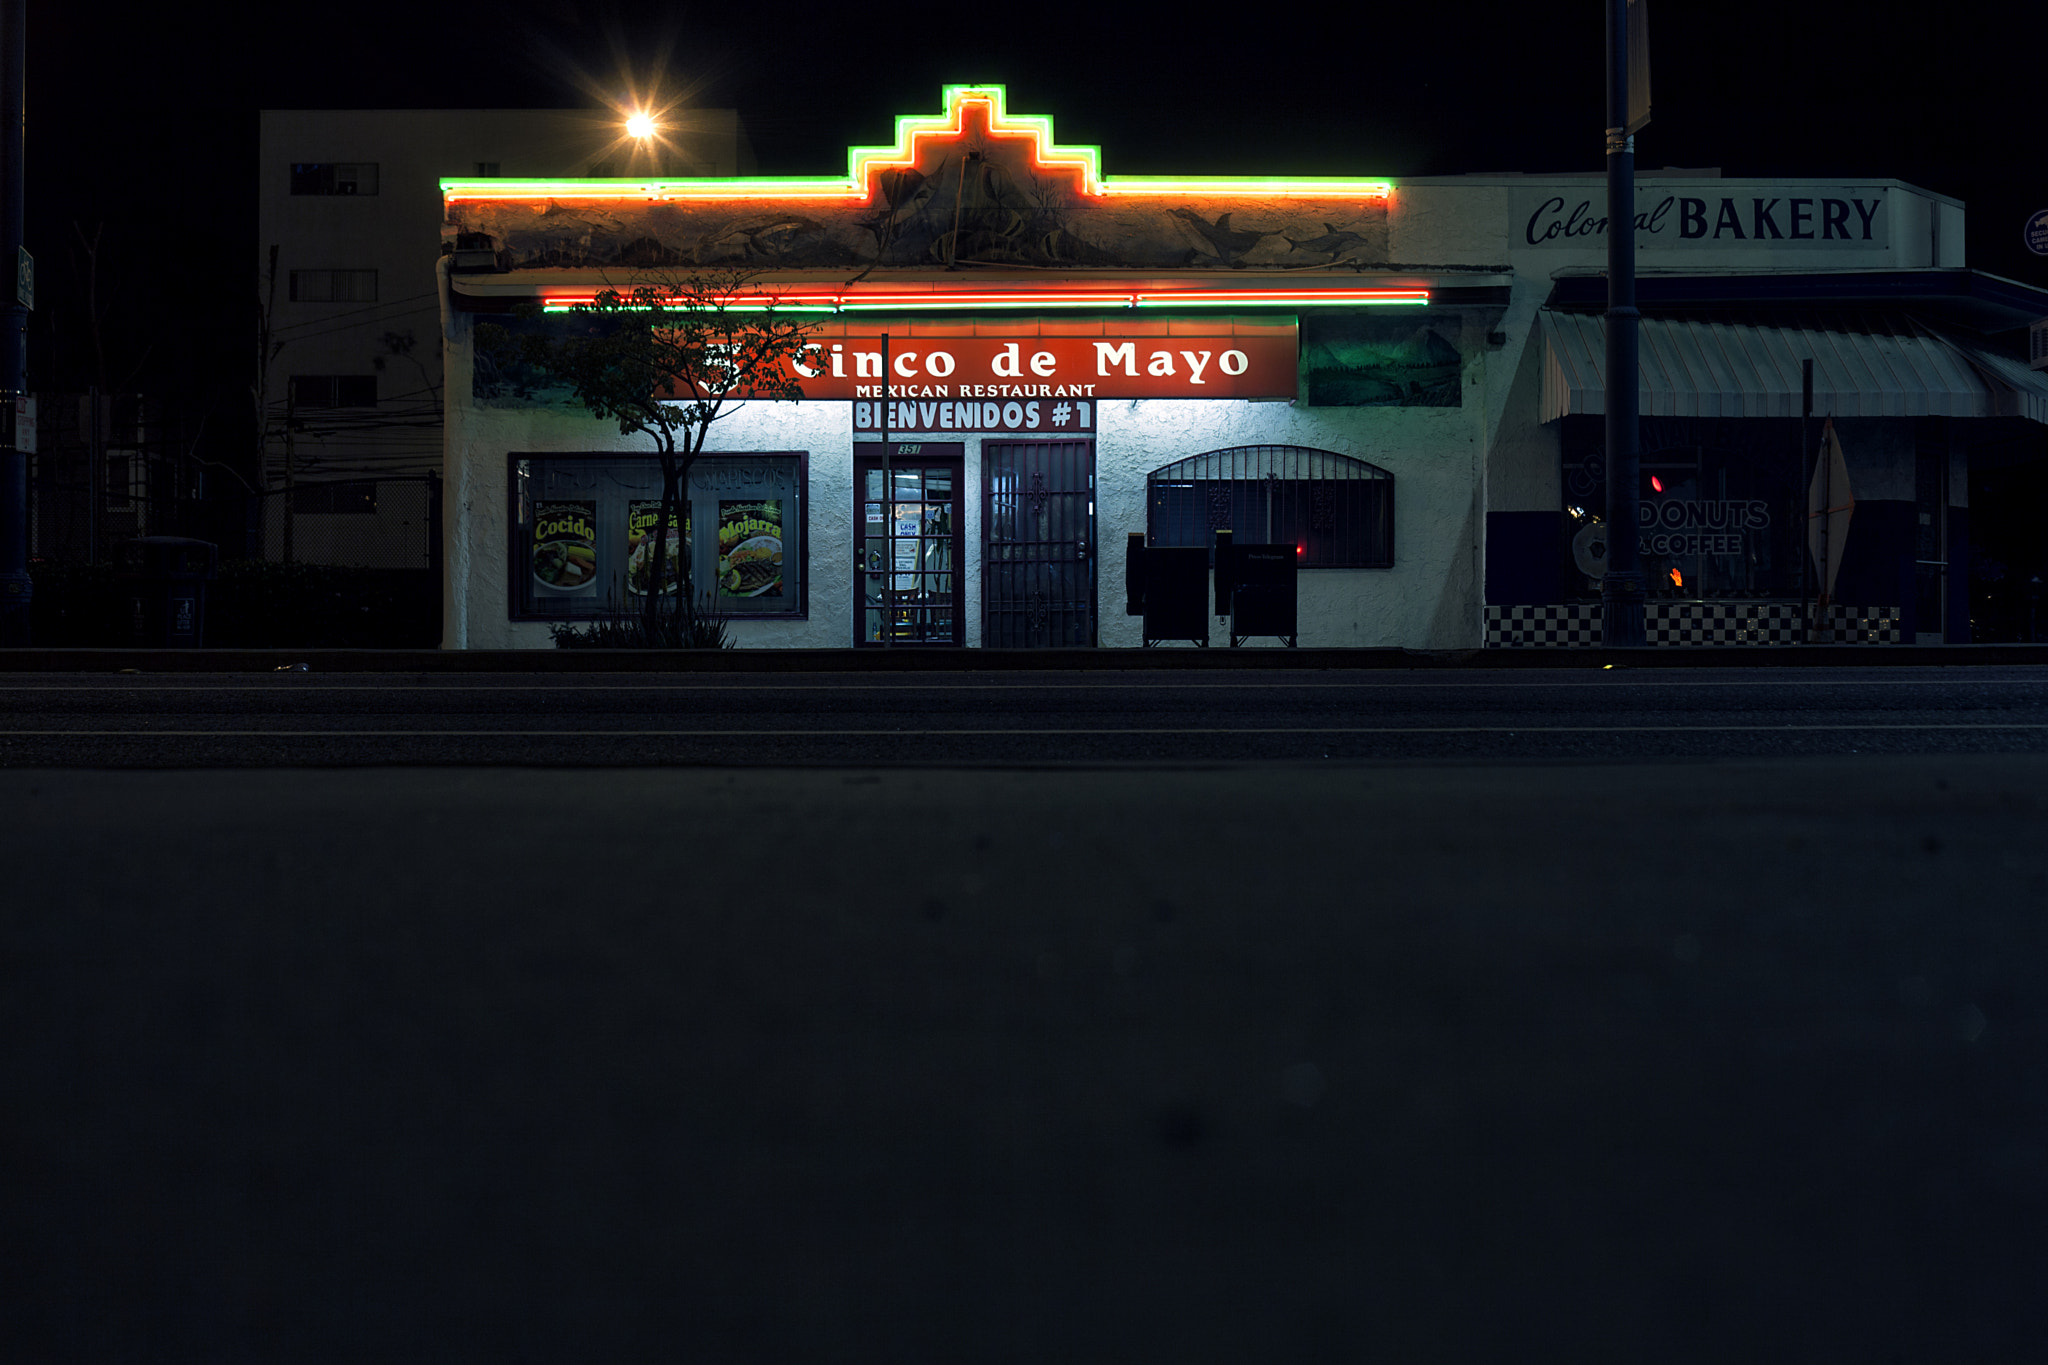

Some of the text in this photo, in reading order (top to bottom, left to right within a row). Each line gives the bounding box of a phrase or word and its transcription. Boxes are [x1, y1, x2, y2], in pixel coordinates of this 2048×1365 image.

[1526, 196, 1881, 245] Colonal BAKERY
[792, 343, 955, 378] Cinco
[991, 342, 1056, 378] de
[1092, 342, 1248, 384] Mayo
[855, 384, 1096, 398] MEXICAN RESTAURANT
[855, 401, 1091, 429] BIENVENIDOS #1
[899, 444, 920, 454] 351
[629, 511, 659, 530] Carne
[900, 523, 916, 531] CASH
[1639, 499, 1771, 530] DONUTS
[535, 515, 595, 541] Cocido
[719, 515, 781, 544] Mojarra
[1651, 534, 1743, 555] COFFEE
